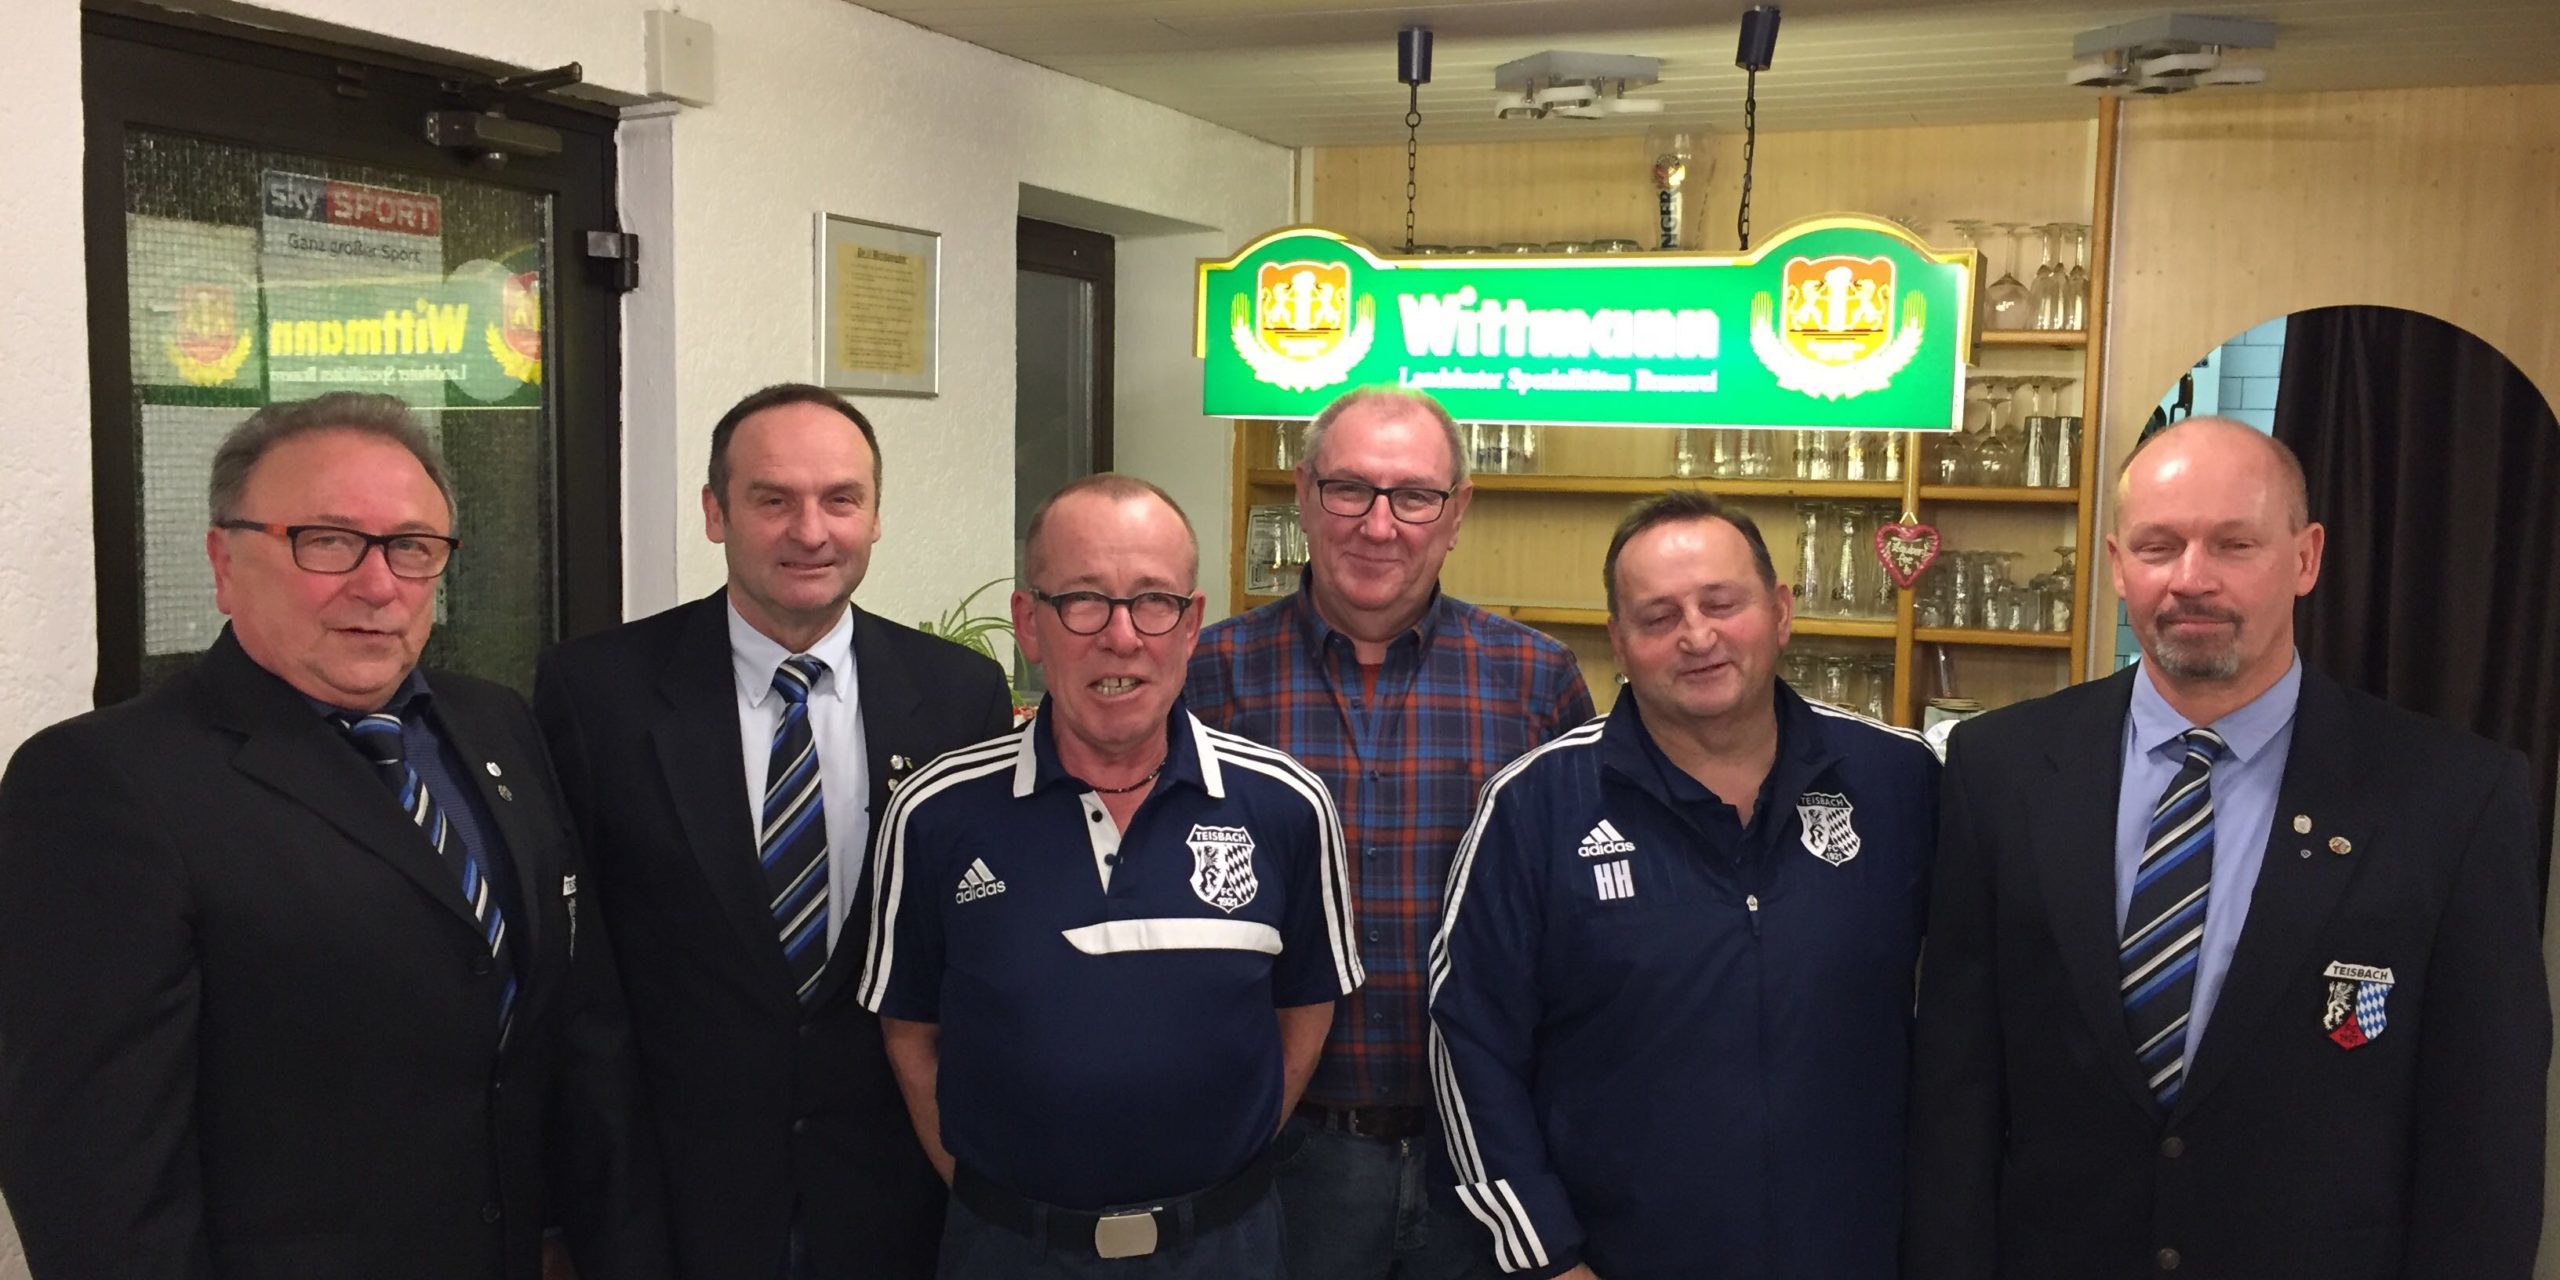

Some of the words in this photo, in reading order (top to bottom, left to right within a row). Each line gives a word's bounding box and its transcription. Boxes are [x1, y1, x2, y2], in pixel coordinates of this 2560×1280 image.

[271, 178, 320, 219] sky
[334, 189, 436, 230] SPORT
[288, 233, 326, 252] Ganz
[381, 245, 421, 263] Sport
[1398, 285, 1720, 359] Wittmann
[1800, 796, 1844, 807] TEISBACH
[1194, 831, 1247, 843] TEISBACH
[1577, 840, 1636, 857] adidas
[1594, 859, 1635, 901] HH
[955, 880, 1006, 904] adidas
[1221, 887, 1233, 896] FC
[2333, 965, 2388, 980] TEISBACH
